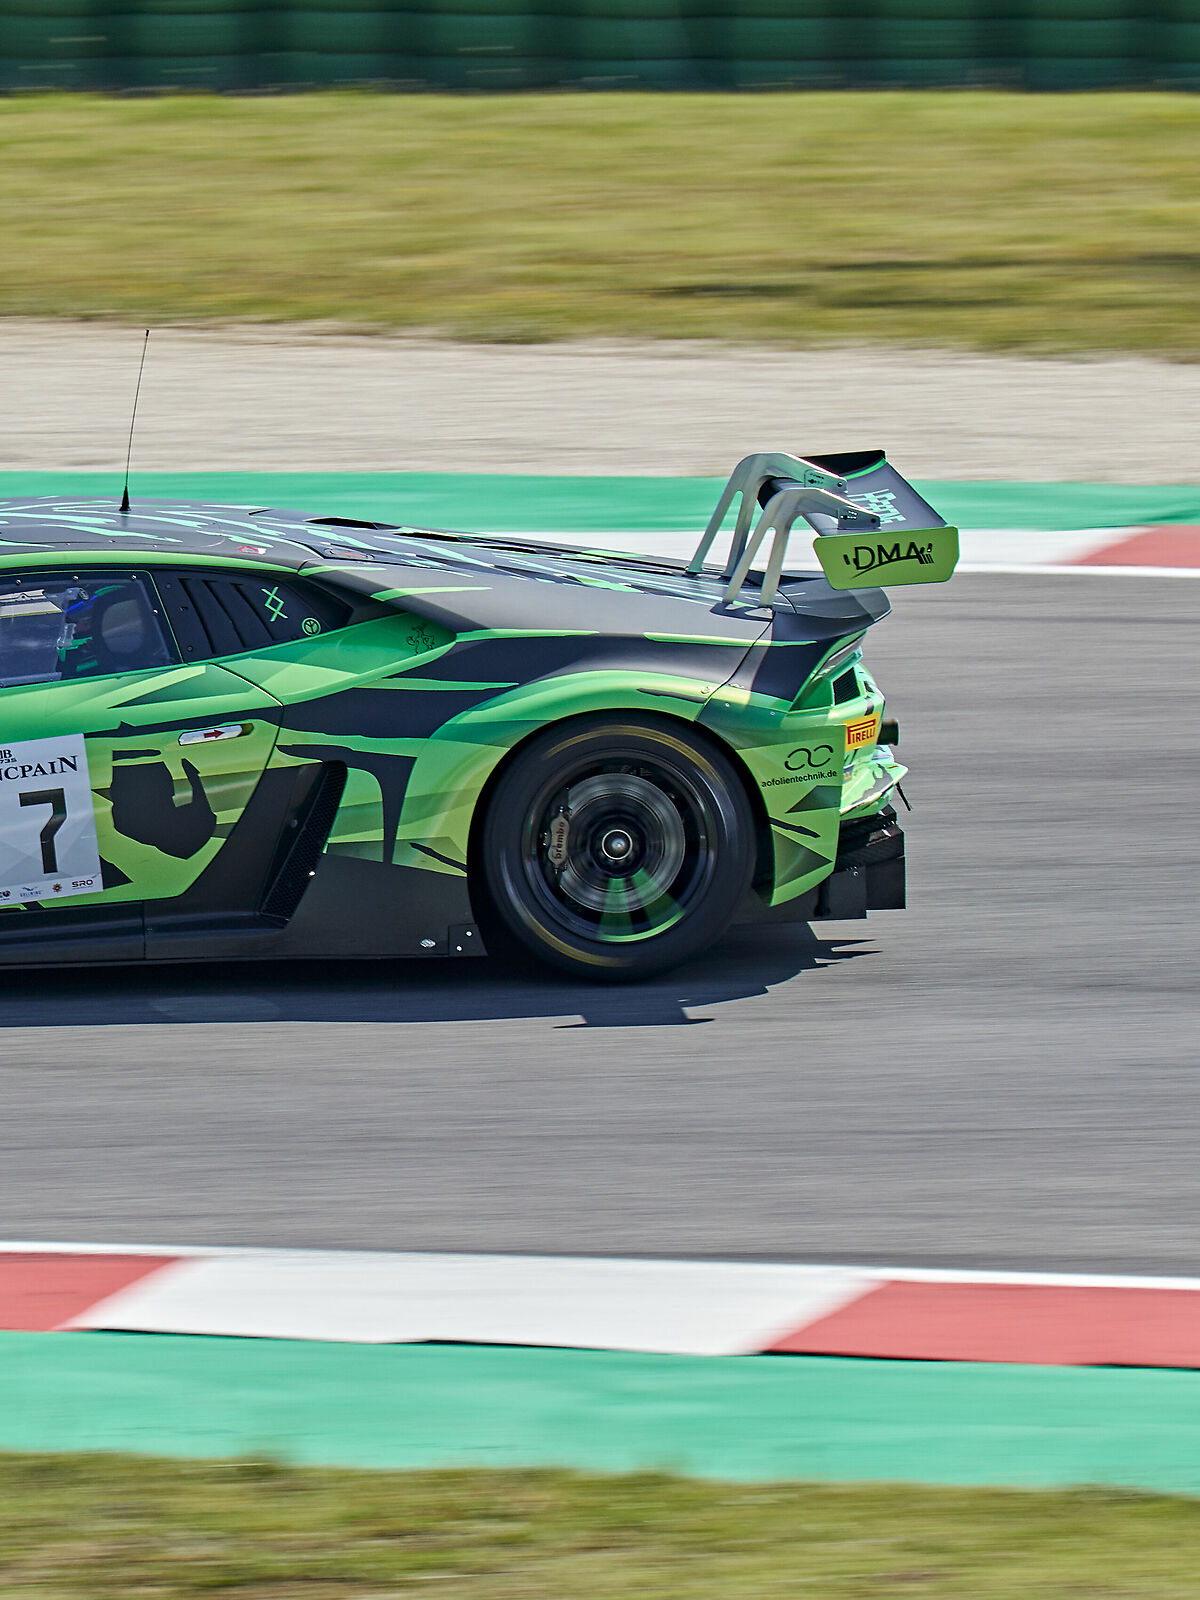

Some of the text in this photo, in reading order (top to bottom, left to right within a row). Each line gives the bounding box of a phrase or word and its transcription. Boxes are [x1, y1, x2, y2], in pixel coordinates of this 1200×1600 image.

[846, 718, 877, 745] PIRELLI
[761, 769, 838, 788] aofolientechnik.de
[552, 821, 565, 859] brembo
[71, 879, 94, 888] SRO
